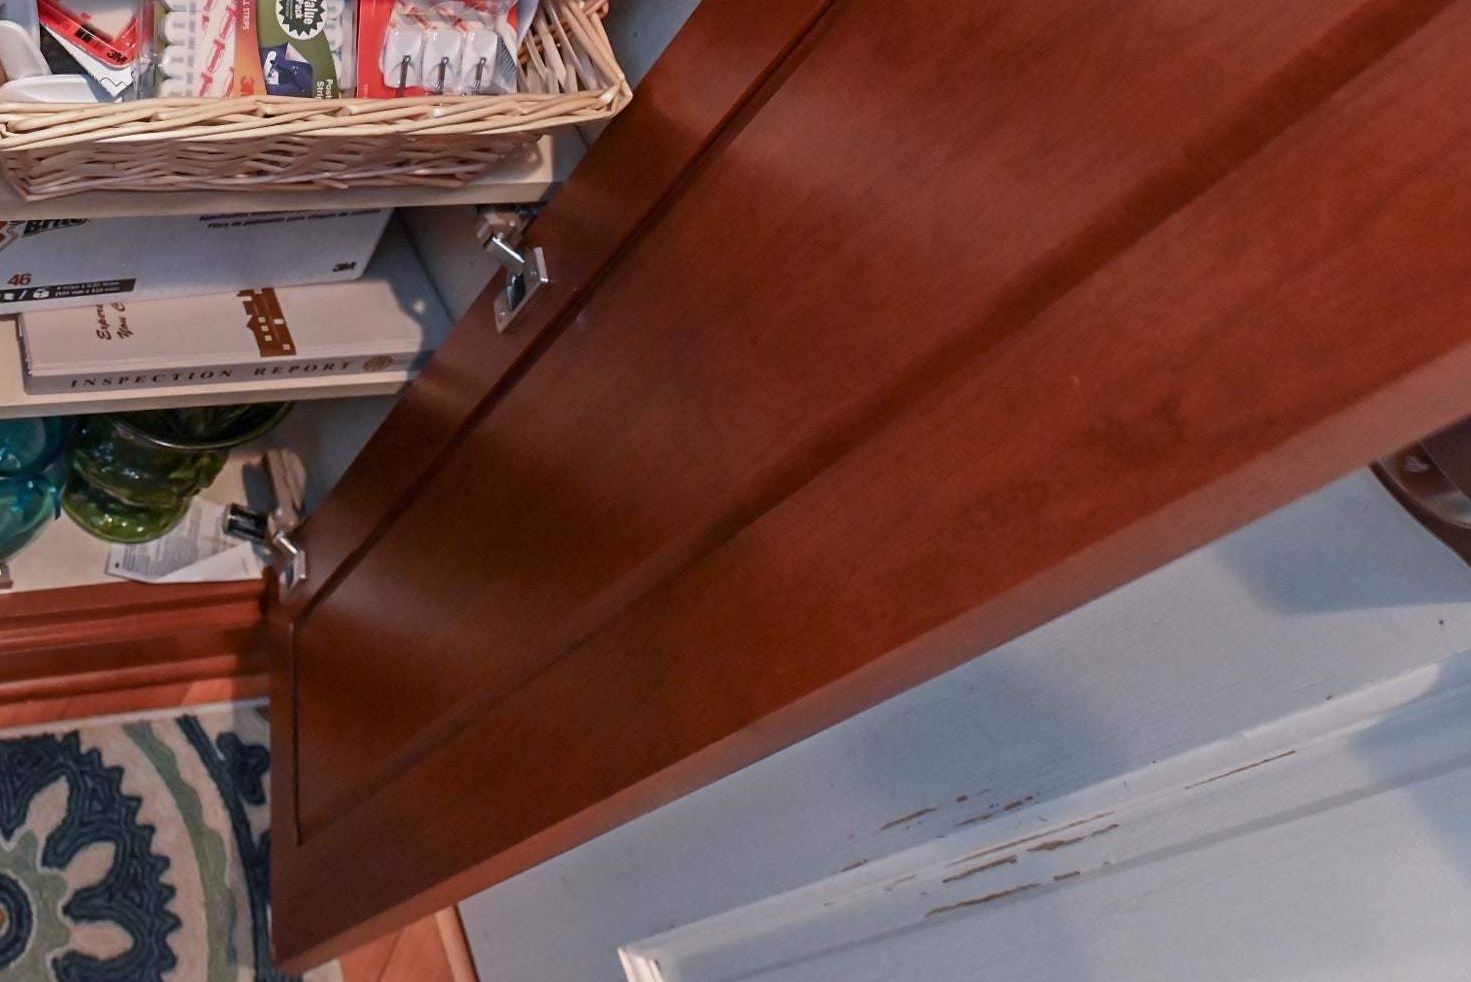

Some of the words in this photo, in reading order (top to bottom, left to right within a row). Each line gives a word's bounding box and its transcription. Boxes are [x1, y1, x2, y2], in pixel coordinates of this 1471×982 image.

[107, 49, 127, 64] 3M
[333, 262, 356, 273] 3M
[7, 273, 31, 287] 46
[117, 317, 134, 339] You
[70, 370, 232, 387] INSPECTION
[253, 361, 352, 376] REPORT
